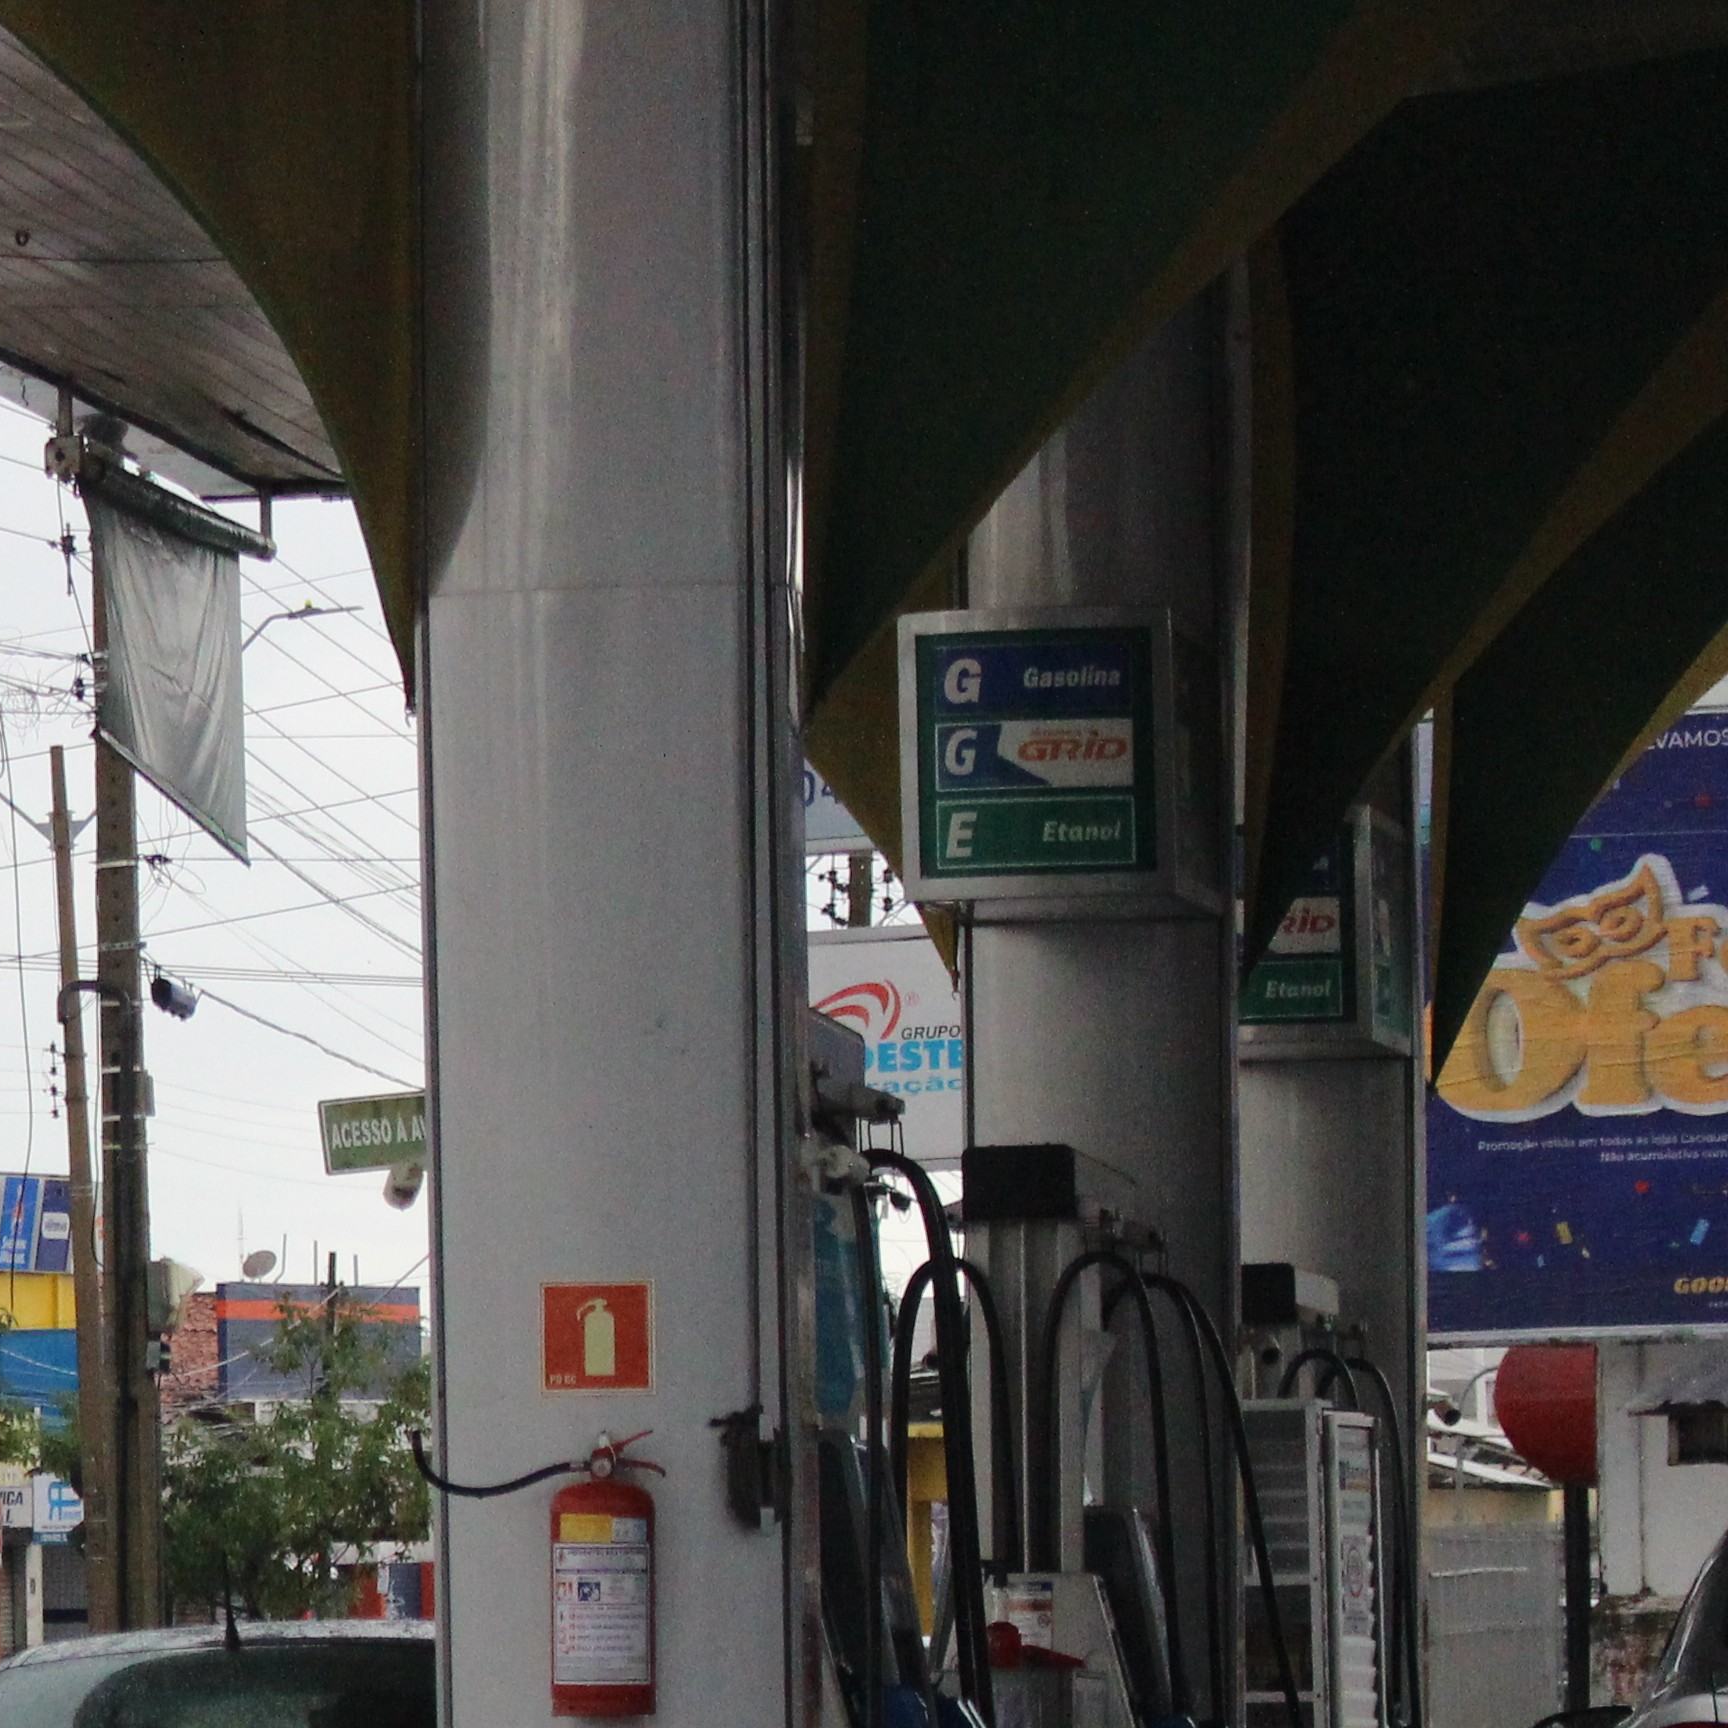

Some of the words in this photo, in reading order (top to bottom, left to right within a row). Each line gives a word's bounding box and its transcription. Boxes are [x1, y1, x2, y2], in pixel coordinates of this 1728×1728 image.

[944, 658, 982, 705] G
[1024, 666, 1121, 688] Gasolina
[945, 728, 978, 776] G
[946, 811, 978, 859] E
[1042, 820, 1121, 842] Etanol
[1265, 979, 1332, 999] Etanol
[901, 1025, 961, 1040] GRUPO
[332, 1116, 392, 1150] ACESSO
